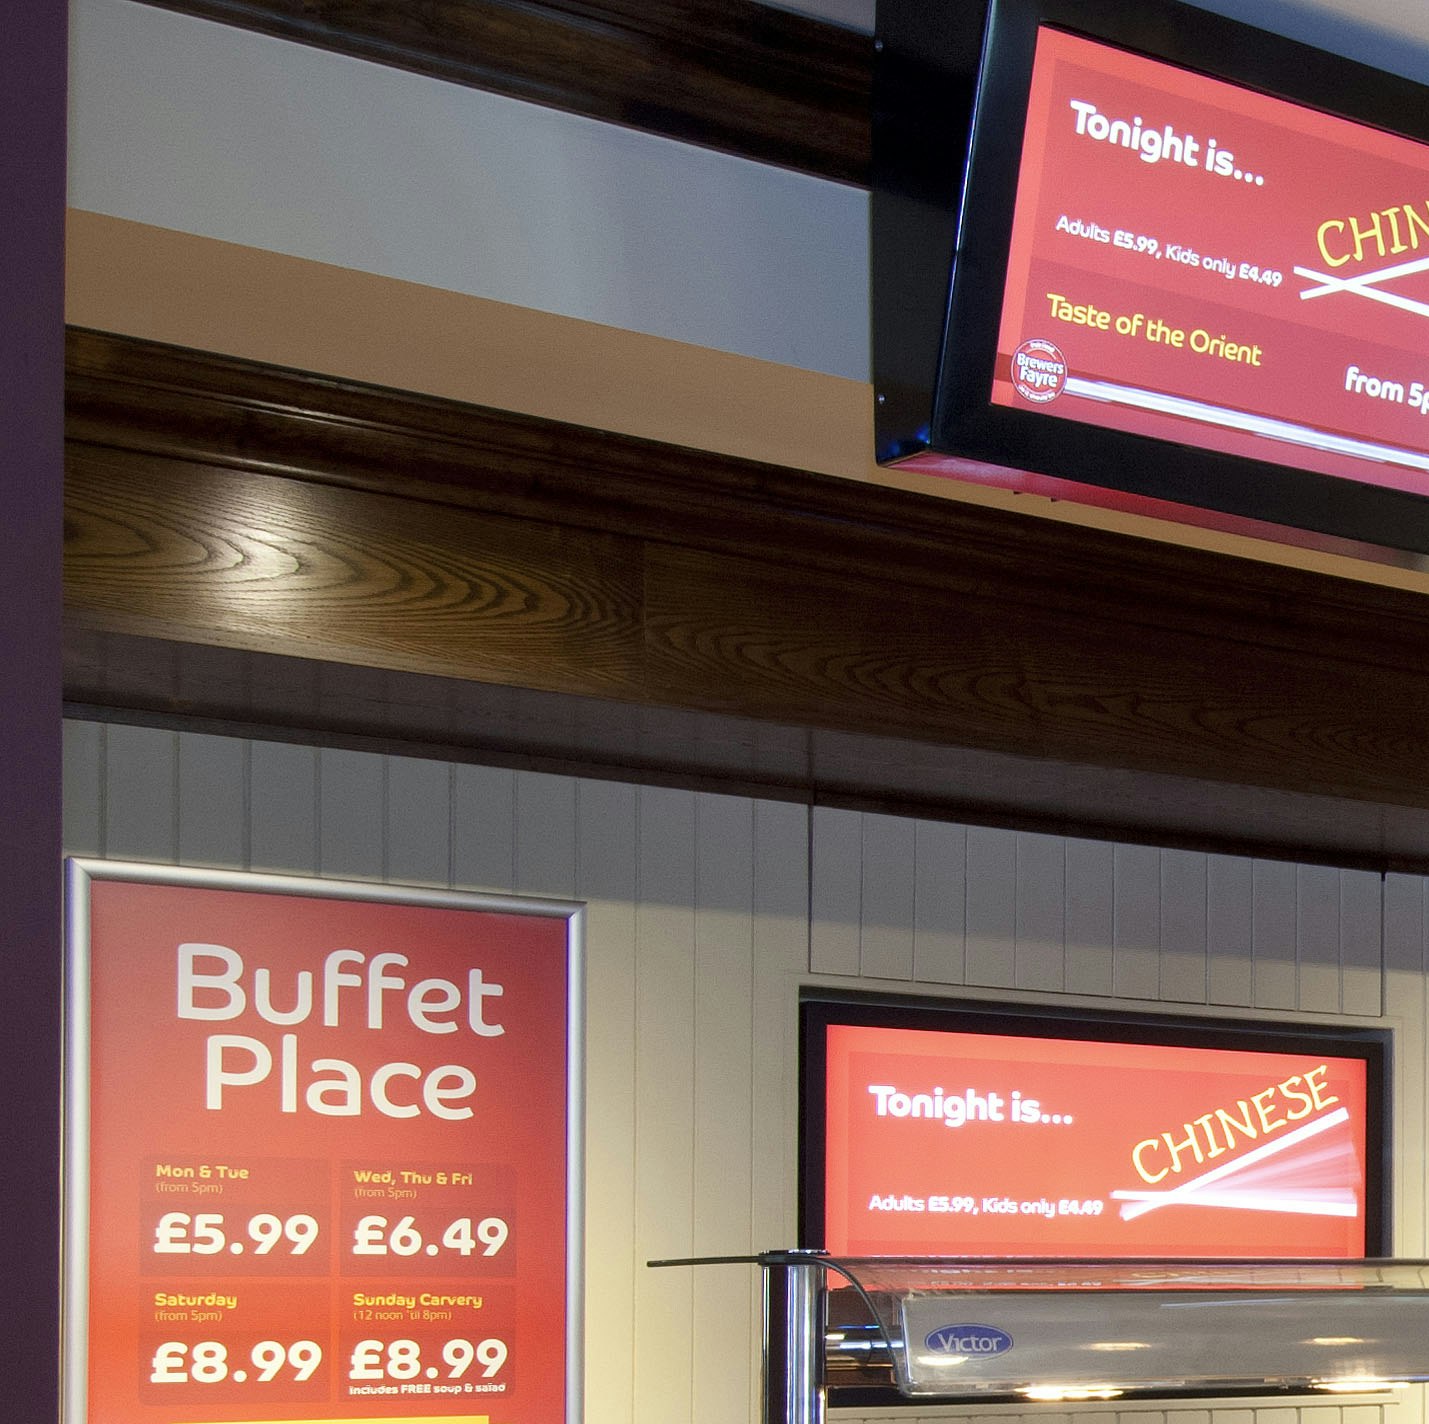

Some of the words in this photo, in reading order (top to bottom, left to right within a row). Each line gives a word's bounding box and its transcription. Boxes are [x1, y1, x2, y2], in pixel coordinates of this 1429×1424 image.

[1070, 99, 1199, 168] Tonight
[1205, 138, 1264, 186] is...
[1056, 215, 1110, 243] Adults
[1113, 229, 1162, 260] £5.99,
[1165, 244, 1200, 267] Kids
[1202, 257, 1236, 280] only
[1238, 263, 1283, 287] £4.49
[1046, 293, 1111, 330] Taste
[1115, 314, 1144, 337] of
[1146, 319, 1185, 348] the
[1190, 329, 1263, 366] Orient
[1017, 353, 1064, 374] Brewers
[1020, 366, 1058, 388] Fayre
[1344, 365, 1403, 404] from
[177, 942, 505, 1037] Buffet
[206, 1033, 477, 1120] Place
[868, 1084, 1004, 1128] Tonight
[1011, 1090, 1074, 1126] is...
[1131, 1064, 1339, 1184] CHINESE
[156, 1164, 194, 1180] Mon
[198, 1165, 211, 1180] &
[215, 1165, 249, 1180] Tue
[353, 1170, 396, 1188] Wed,
[400, 1171, 433, 1185] Thu
[436, 1171, 448, 1185] &
[451, 1172, 473, 1186] Fri
[155, 1181, 189, 1194] (from
[190, 1181, 223, 1195] 5pm)
[354, 1187, 387, 1199] (from
[388, 1187, 417, 1200] 5pm)
[868, 1194, 925, 1212] Adults
[927, 1196, 978, 1215] £5.99,
[982, 1197, 1018, 1214] Kids
[1020, 1198, 1056, 1218] only
[1057, 1199, 1104, 1215] £4.49
[153, 1211, 319, 1256] £5.99
[352, 1215, 509, 1257] £6.49
[154, 1292, 238, 1310] Saturday
[353, 1293, 416, 1309] Sunday
[420, 1293, 483, 1309] Carvery
[155, 1309, 188, 1323] (from
[190, 1309, 222, 1323] 5pm)
[375, 1311, 404, 1320] noon
[423, 1309, 452, 1322] 8pm)
[936, 1332, 1002, 1353] Victor
[150, 1341, 322, 1384] £8.99
[348, 1338, 508, 1380] £8.99
[349, 1384, 399, 1395] Includes
[401, 1383, 432, 1394] FREE
[433, 1384, 462, 1395] soup
[464, 1383, 473, 1393] &
[475, 1382, 506, 1392] salad
